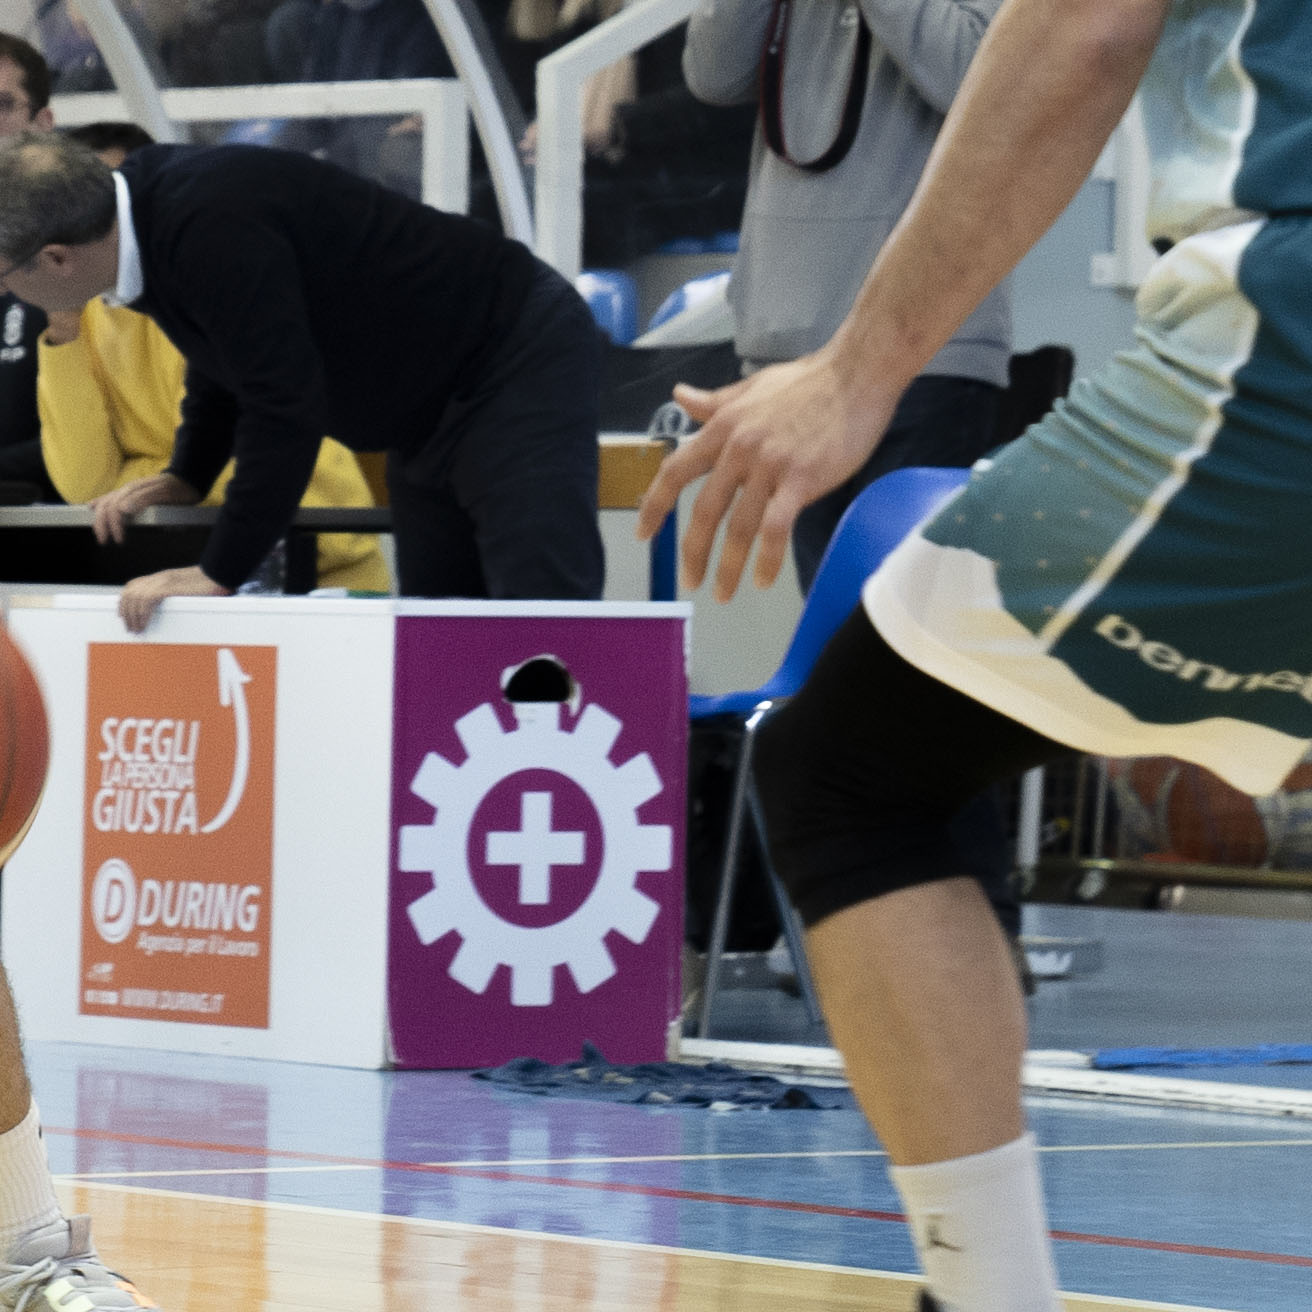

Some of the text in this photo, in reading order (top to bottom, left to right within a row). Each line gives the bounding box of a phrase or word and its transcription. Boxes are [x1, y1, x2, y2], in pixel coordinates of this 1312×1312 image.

[97, 716, 201, 763] SCEGLI
[92, 787, 201, 835] GIUSTA
[136, 878, 262, 933] DURING
